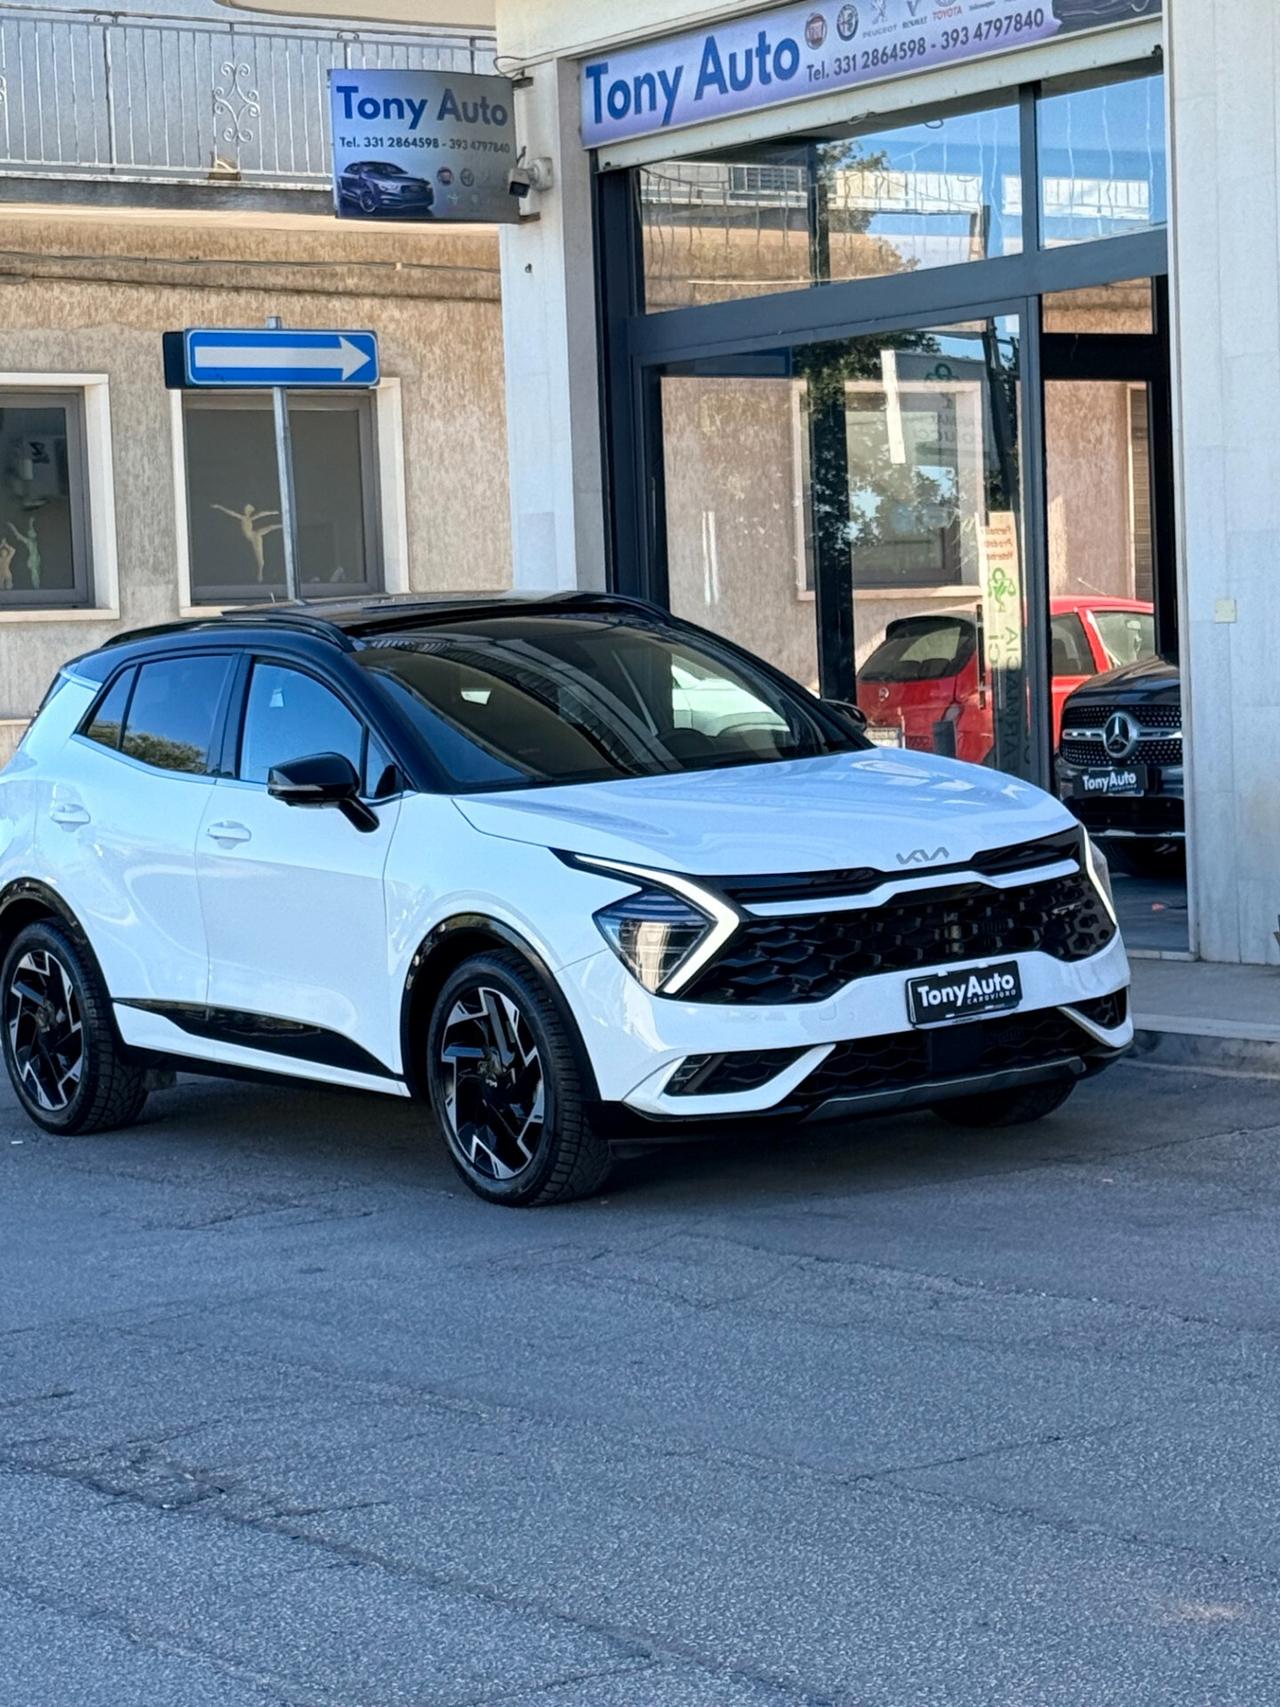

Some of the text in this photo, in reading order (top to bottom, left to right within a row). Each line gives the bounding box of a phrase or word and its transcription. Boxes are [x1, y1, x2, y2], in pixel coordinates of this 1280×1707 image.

[932, 5, 963, 21] TOYOTA
[807, 64, 830, 83] Tel.
[834, 56, 857, 77] 331
[861, 37, 926, 70] 2864598
[941, 27, 969, 50] 393
[973, 8, 1044, 41] 4797840
[862, 24, 897, 39] PEUGEOT
[586, 31, 800, 126] Tony Auto
[336, 85, 508, 130] Tony Auto
[340, 137, 360, 148] Tel.
[364, 137, 384, 148] 331
[387, 137, 440, 149] 2864598
[449, 138, 468, 150] 393
[470, 140, 511, 154] 4797840
[1082, 771, 1137, 792] TonyAuto
[917, 972, 1015, 1007] TonyAuto
